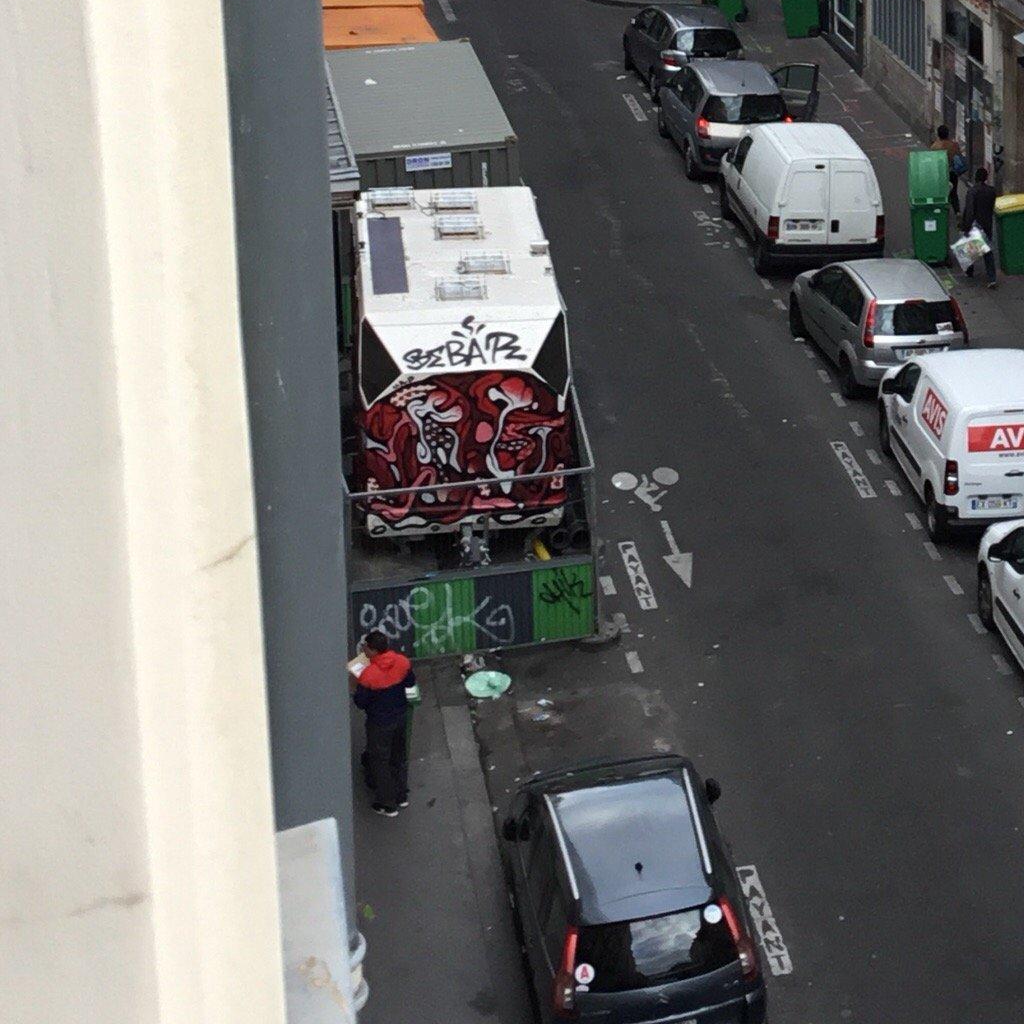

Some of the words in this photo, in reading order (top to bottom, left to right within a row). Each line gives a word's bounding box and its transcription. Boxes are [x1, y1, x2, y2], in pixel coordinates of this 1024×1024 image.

[922, 393, 947, 437] AVIS
[620, 543, 652, 608] PAYANT
[738, 868, 786, 971] PAYANT
[580, 965, 589, 979] A
